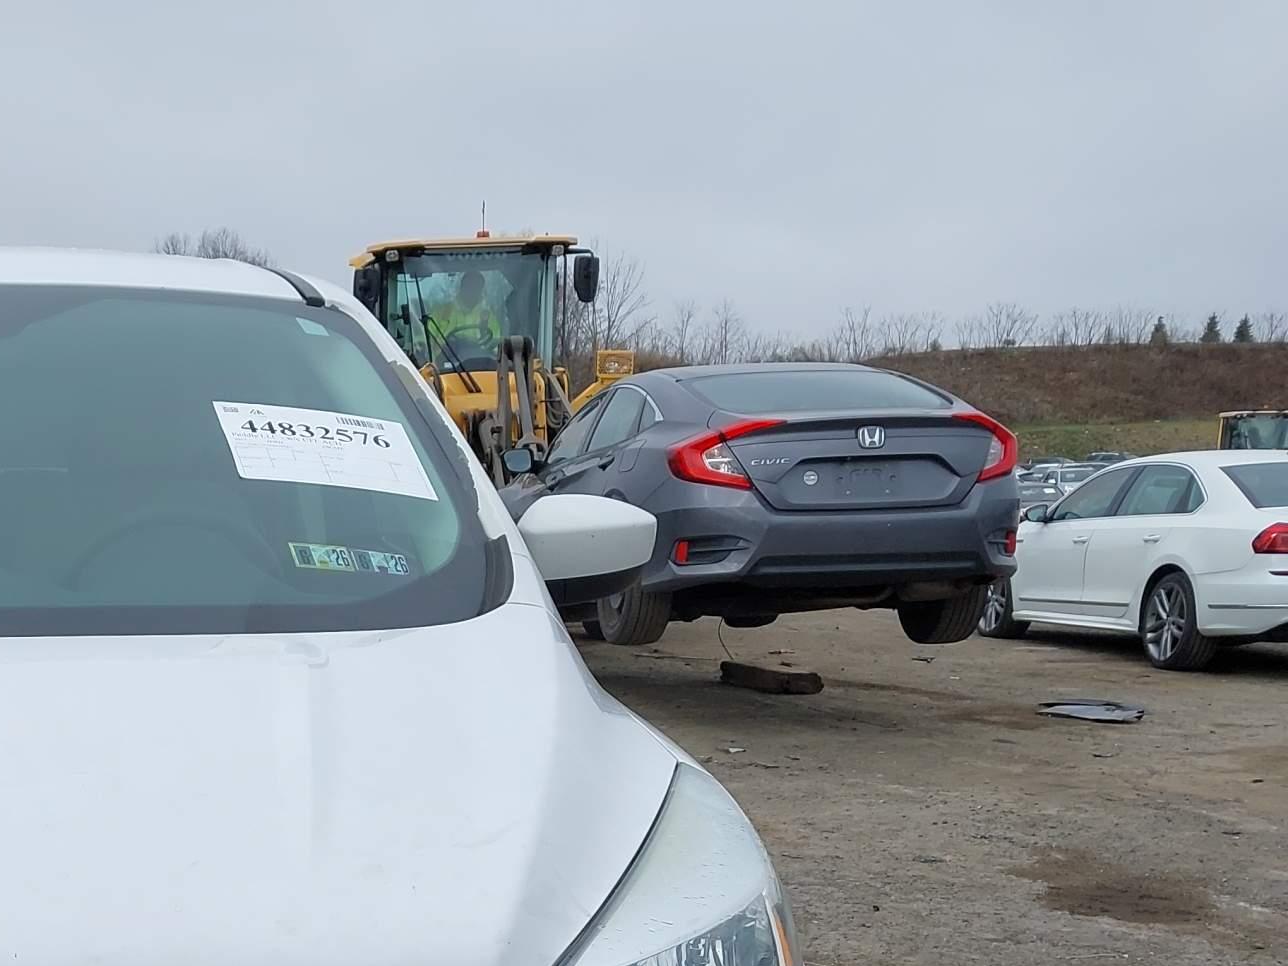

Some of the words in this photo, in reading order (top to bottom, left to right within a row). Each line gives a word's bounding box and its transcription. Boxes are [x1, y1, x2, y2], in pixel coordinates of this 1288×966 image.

[240, 419, 391, 449] 44832576
[751, 457, 791, 466] CIVIC
[332, 549, 350, 567] 26
[391, 555, 409, 573] 26
